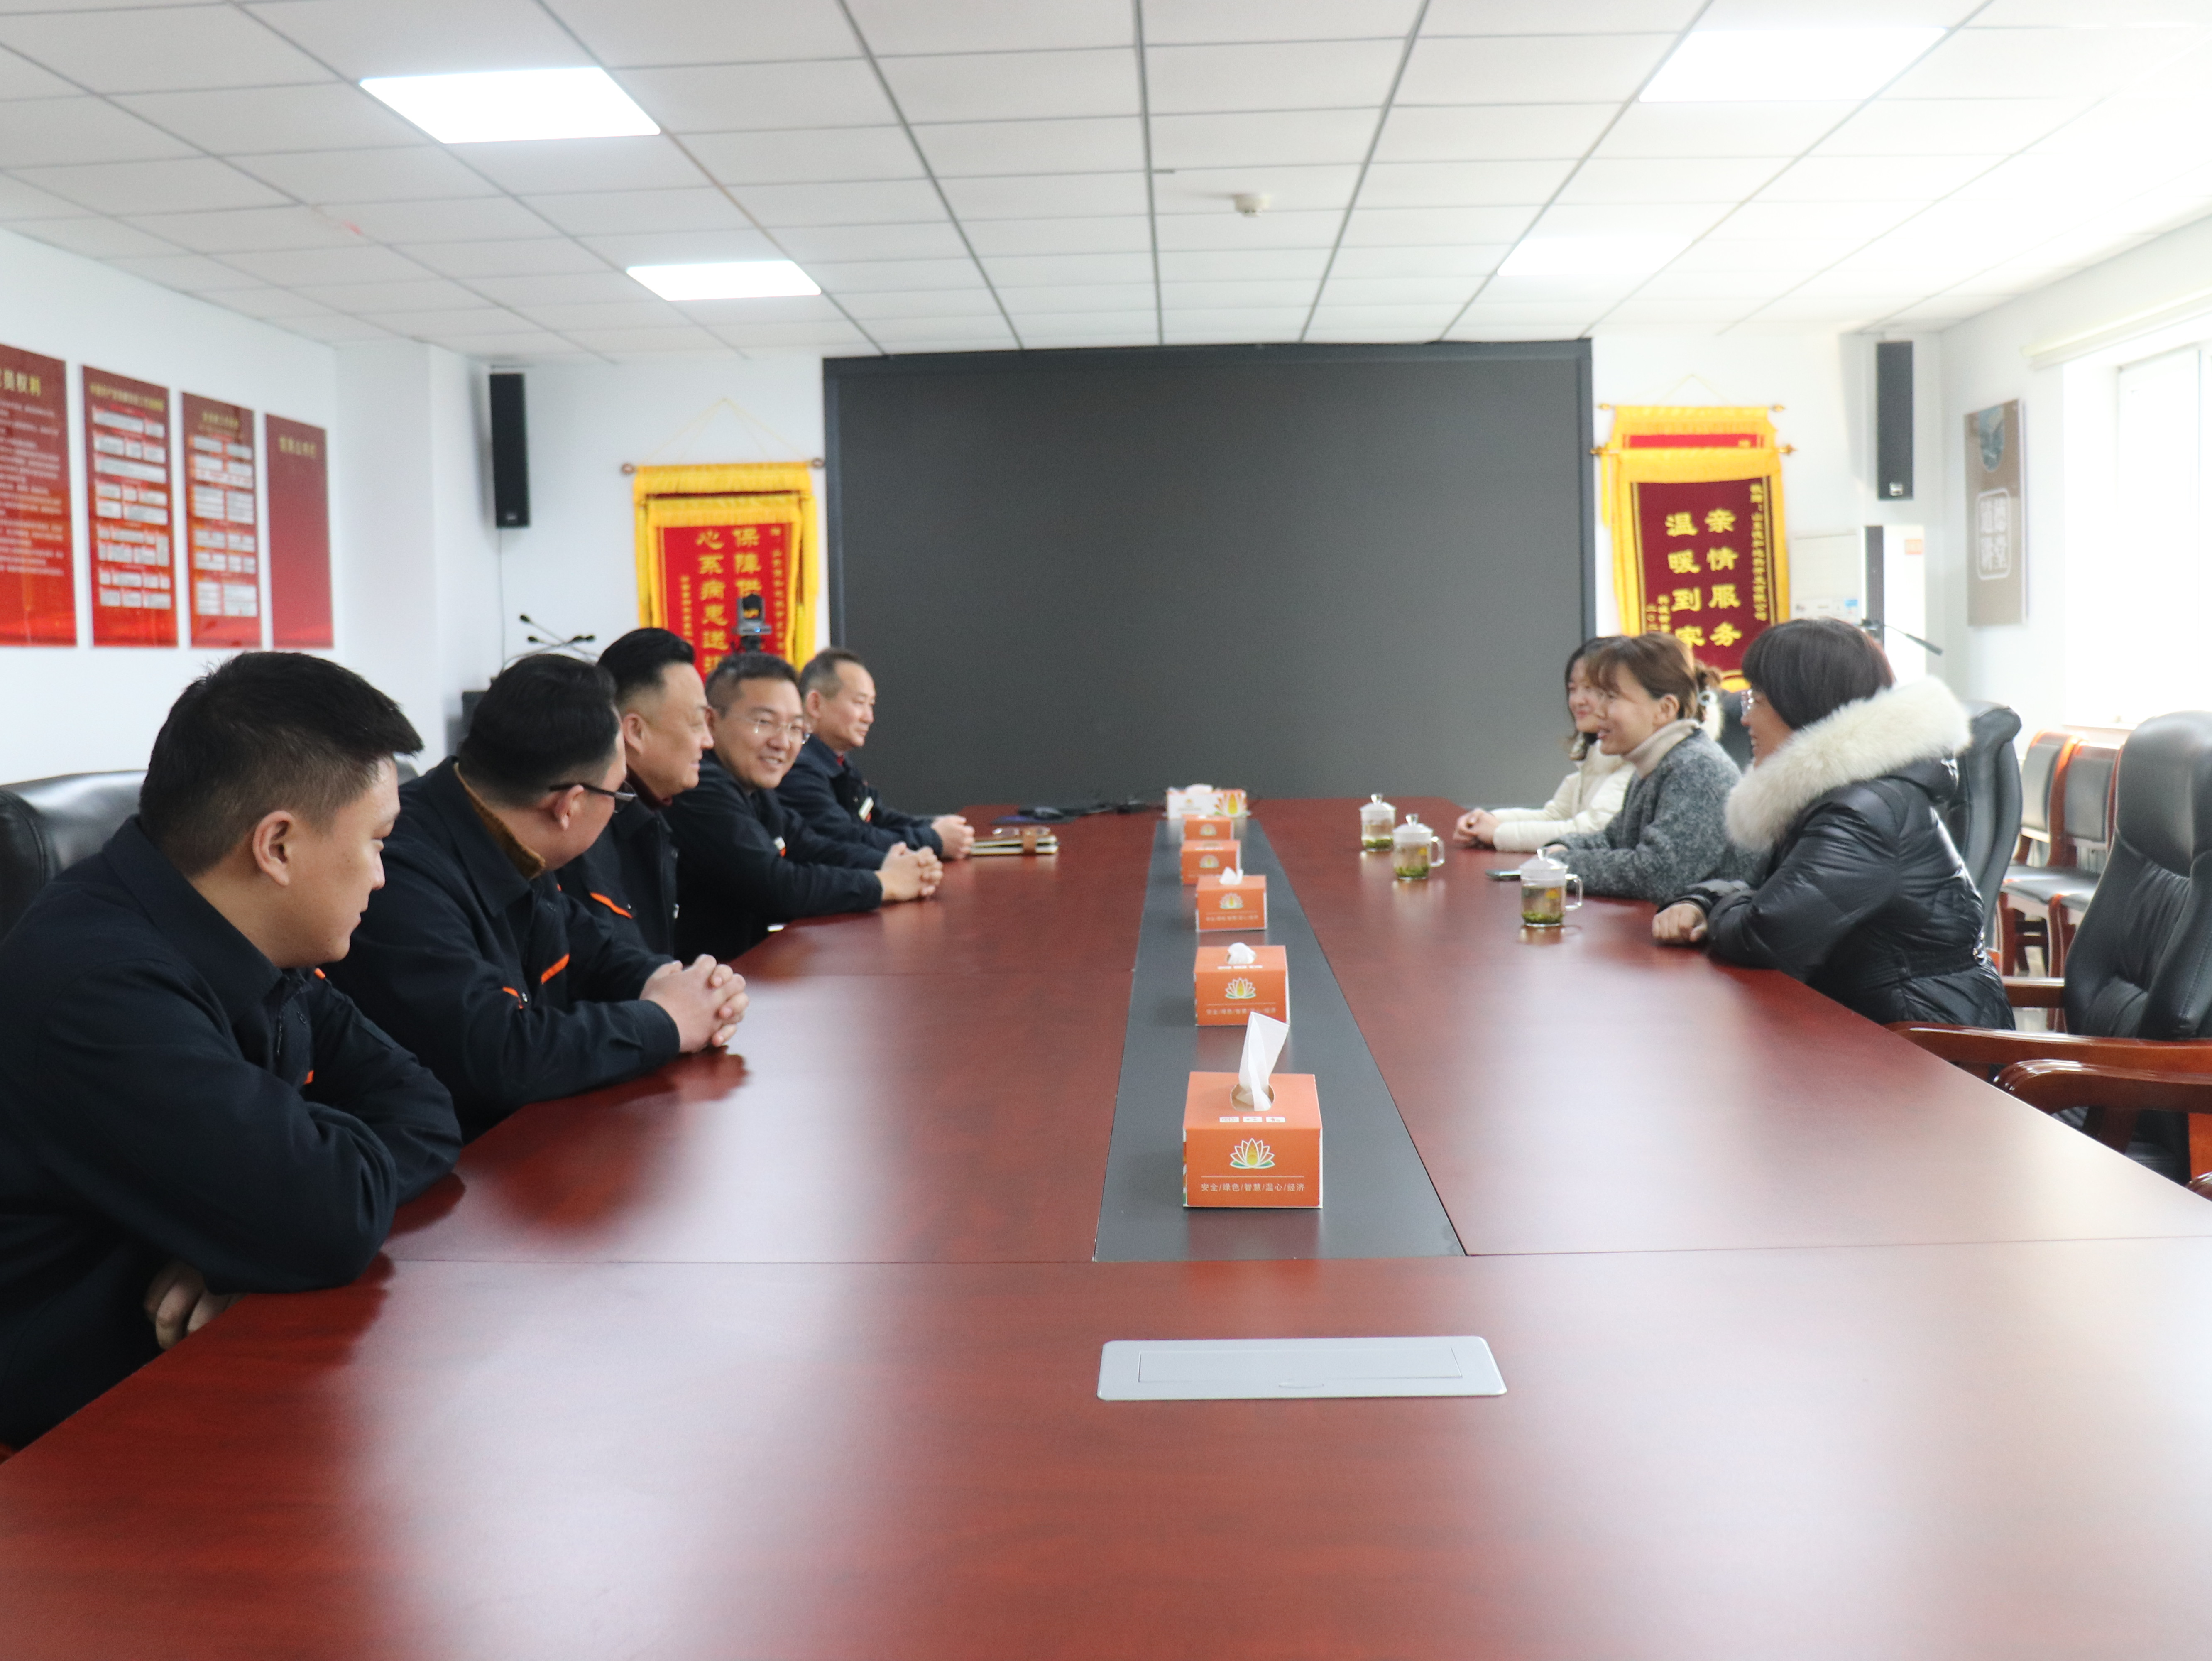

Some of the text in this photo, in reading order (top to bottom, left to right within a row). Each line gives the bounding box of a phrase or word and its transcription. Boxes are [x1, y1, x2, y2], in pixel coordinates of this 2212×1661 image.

[1665, 511, 1706, 648] 温暖到家
[1704, 507, 1743, 647] 亲情服务
[1201, 1183, 1305, 1192] 安全/绿色/智慧/温心/经济
